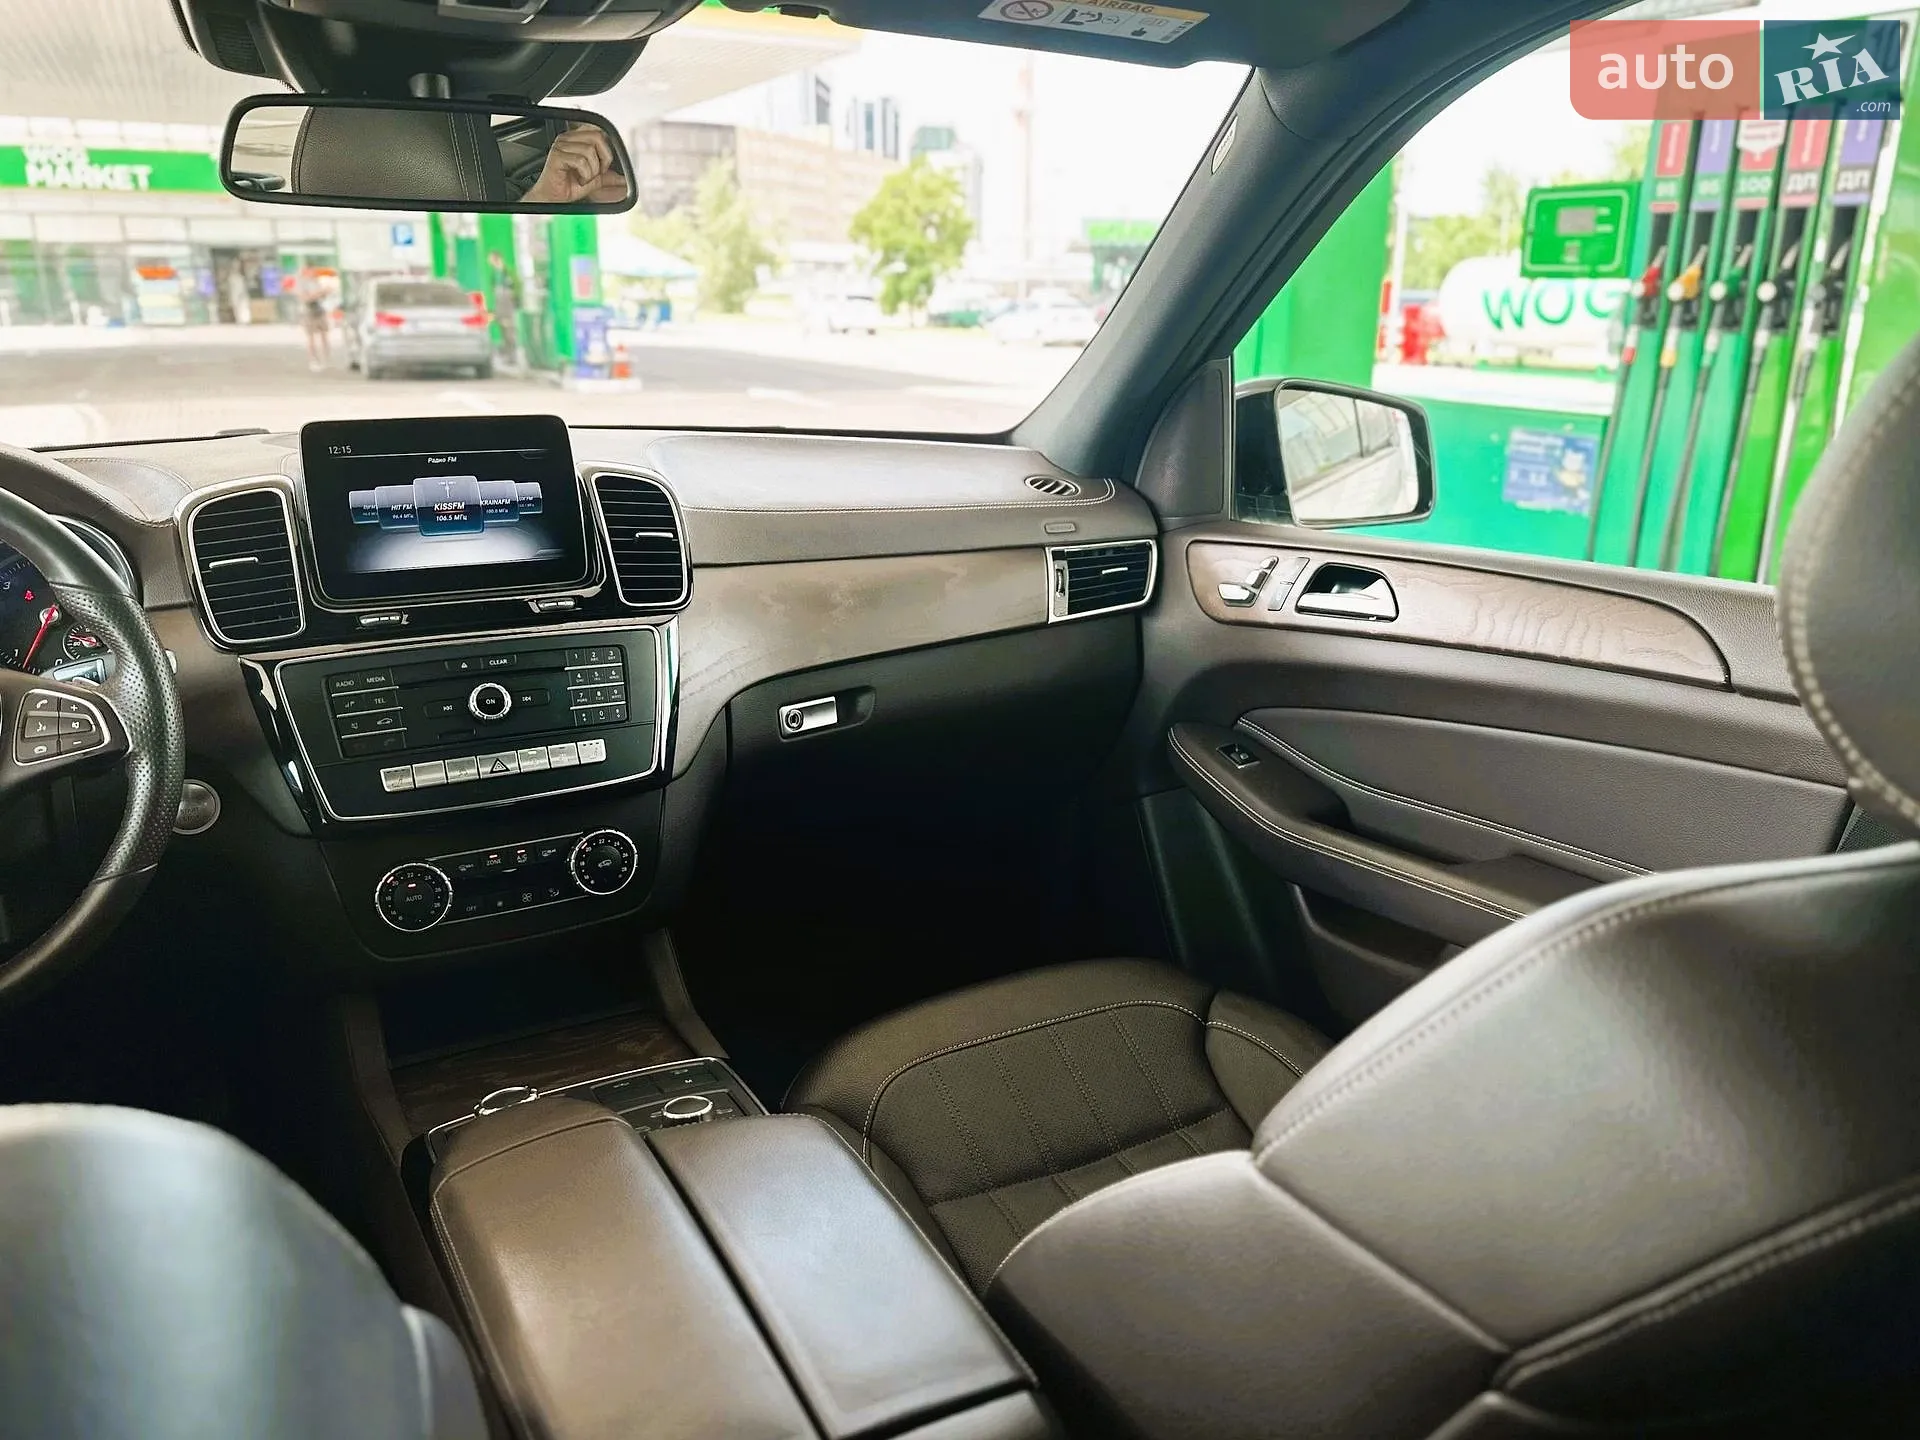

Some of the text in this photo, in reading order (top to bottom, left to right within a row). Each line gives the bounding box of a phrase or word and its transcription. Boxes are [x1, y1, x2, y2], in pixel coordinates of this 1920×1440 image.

[25, 162, 152, 191] MARKET
[1837, 168, 1872, 192] ДП
[1738, 175, 1774, 194] 100
[1482, 277, 1629, 330] WOG
[328, 445, 352, 454] 12:15
[434, 501, 465, 511] KISSFM
[436, 514, 453, 522] 106.5
[3, 581, 11, 590] 3
[14, 648, 19, 657] 1
[336, 680, 355, 688] RADIO
[405, 894, 423, 902] AUTO
